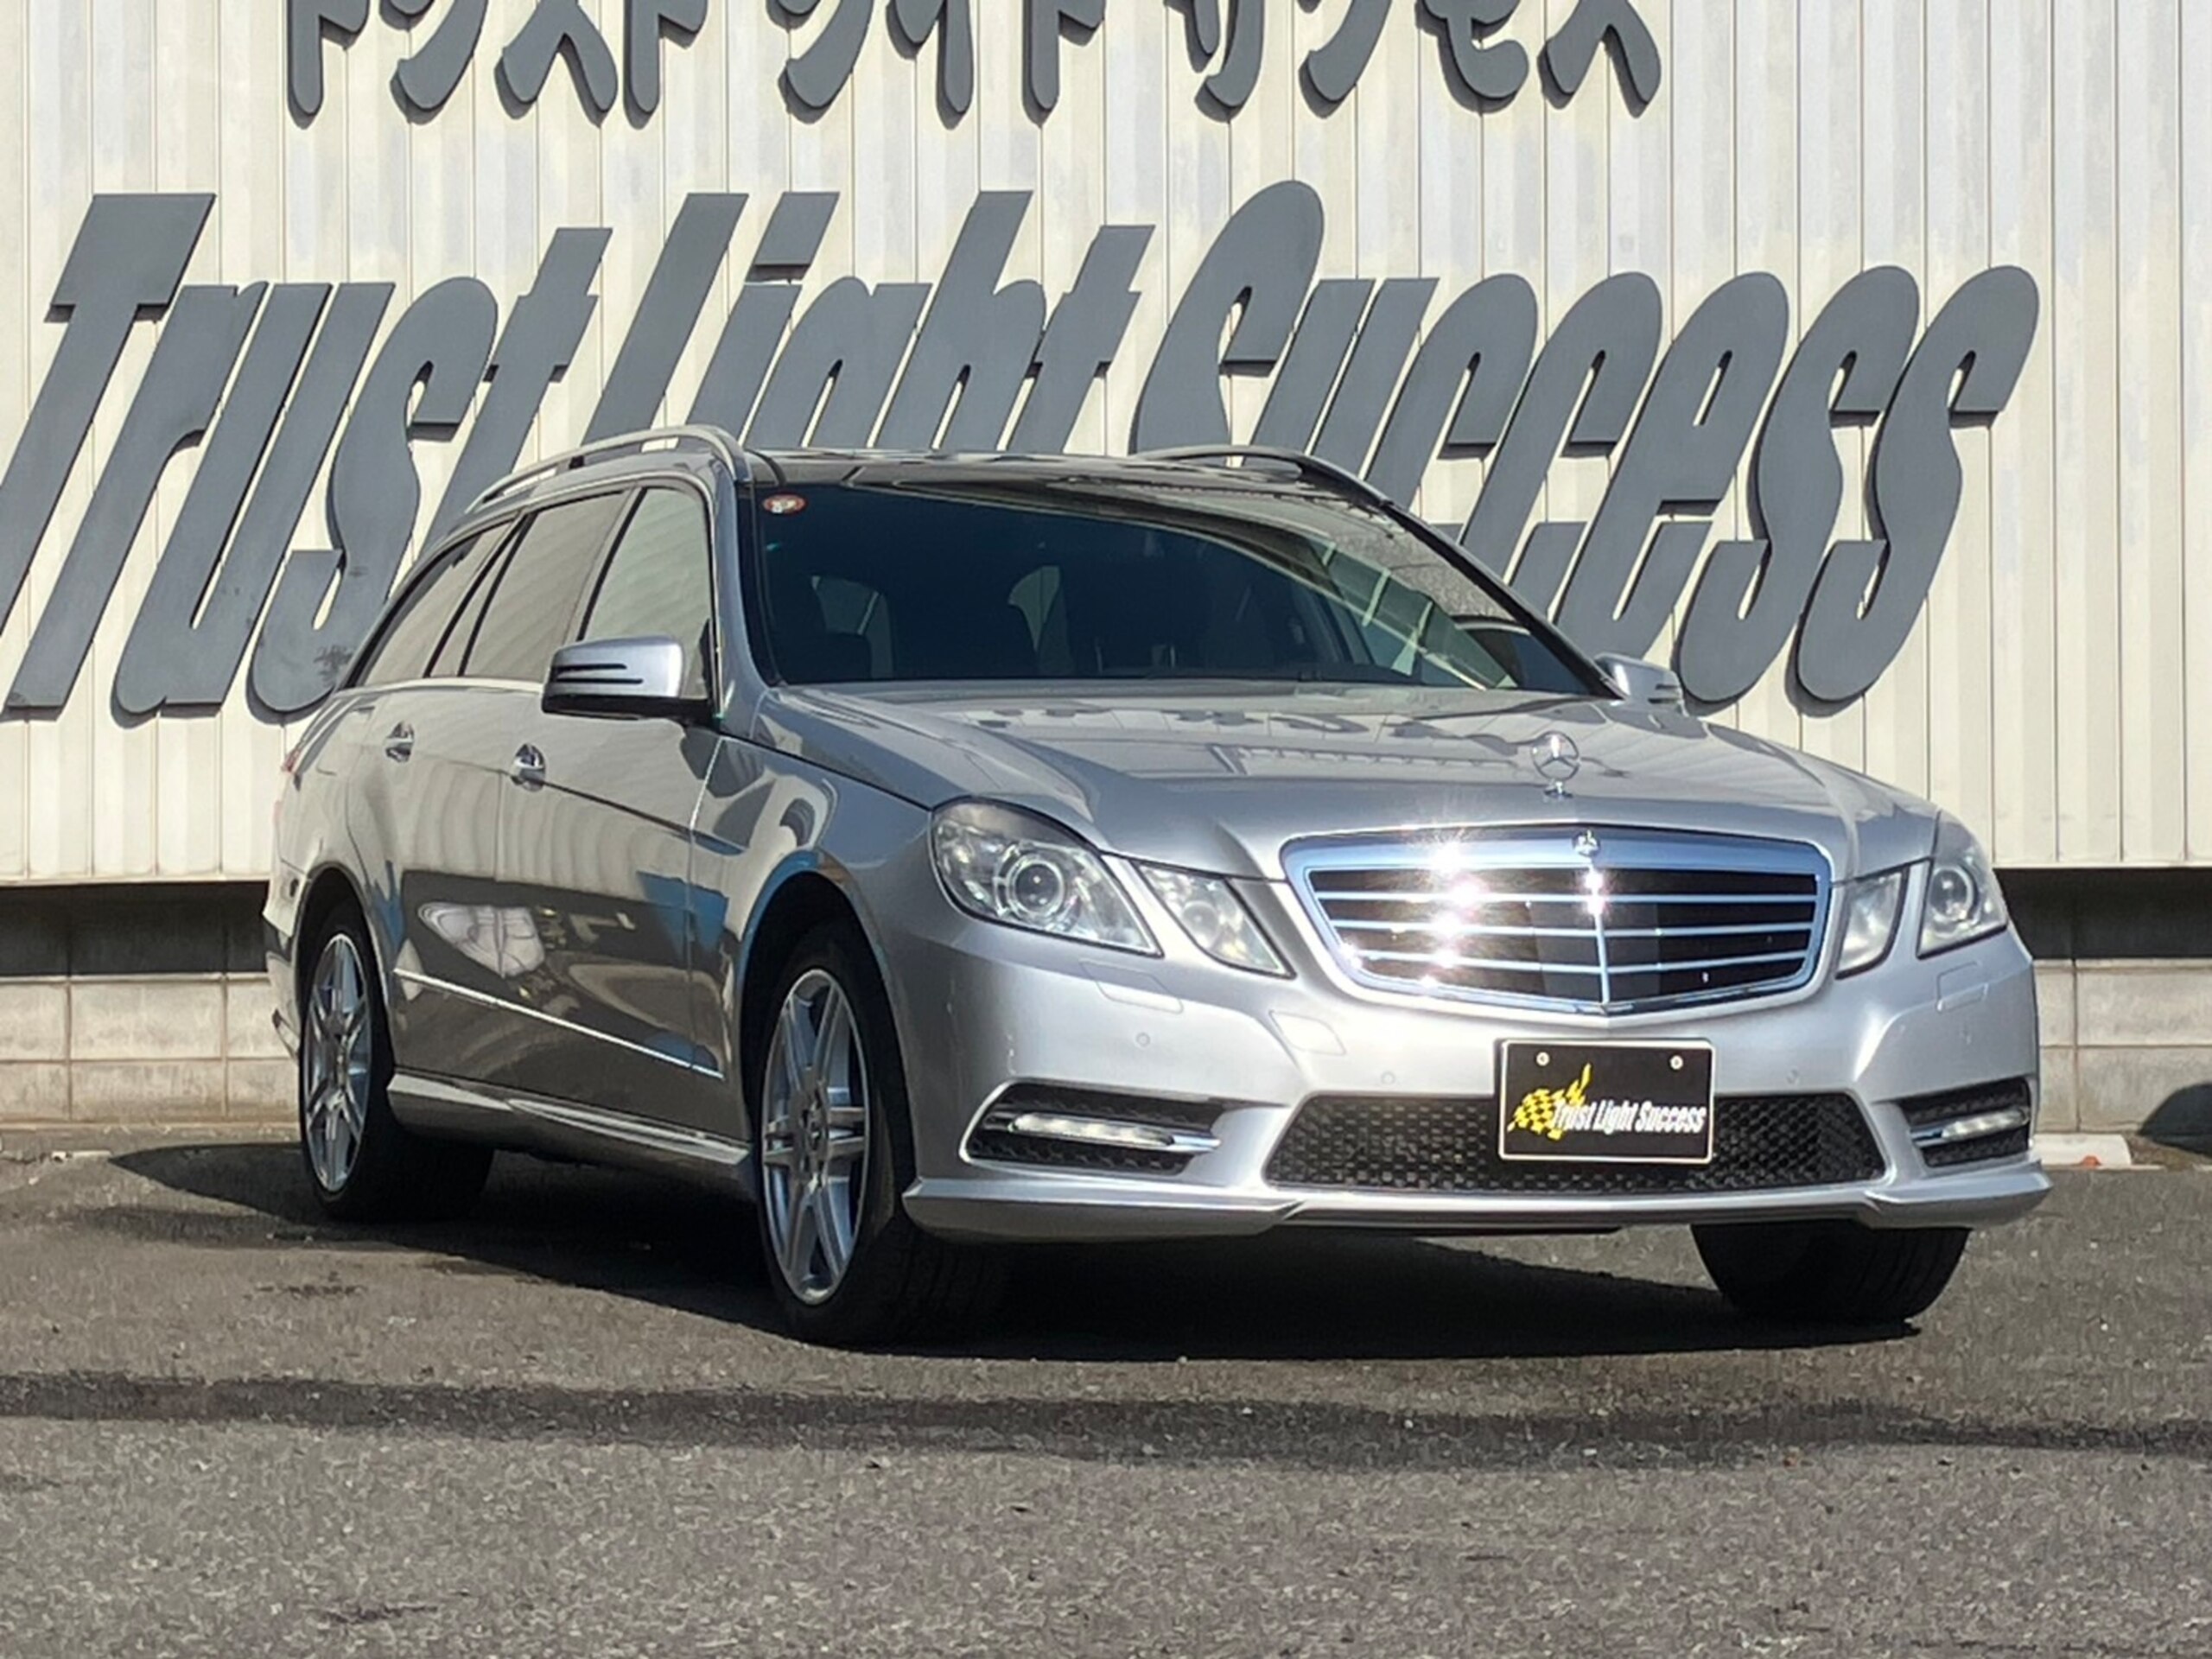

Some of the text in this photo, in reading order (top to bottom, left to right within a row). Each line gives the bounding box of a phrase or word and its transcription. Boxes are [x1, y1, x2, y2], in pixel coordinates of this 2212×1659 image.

[0, 193, 613, 715] Trust
[1551, 1098, 1707, 1135] Trust Light Success
